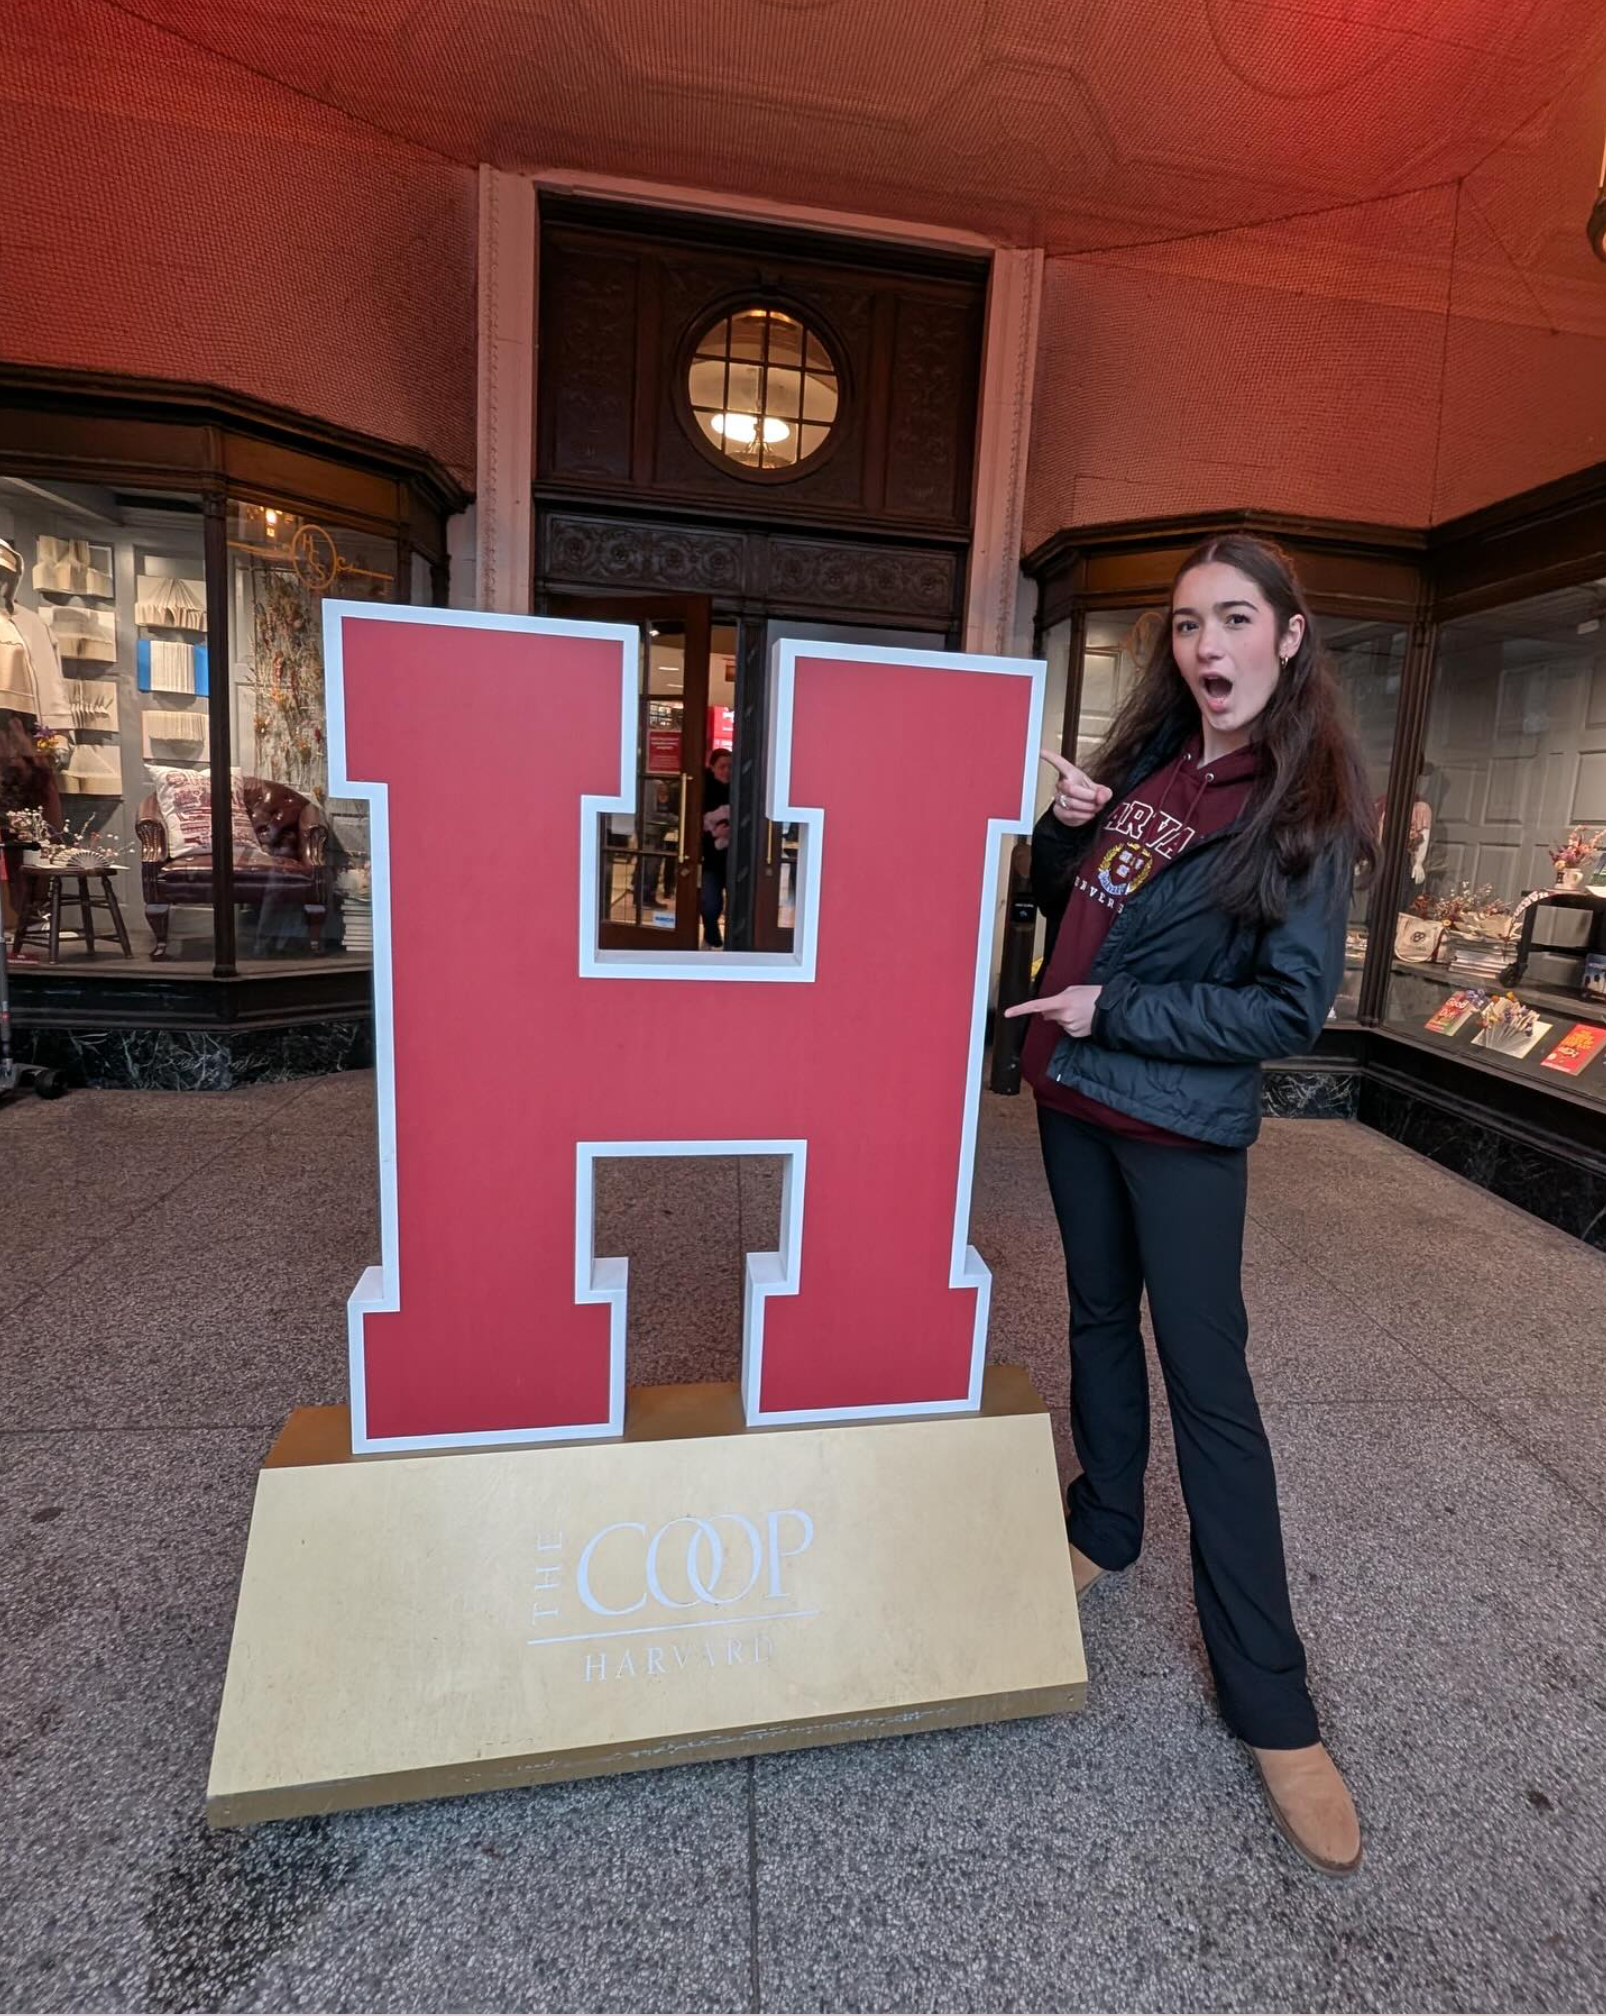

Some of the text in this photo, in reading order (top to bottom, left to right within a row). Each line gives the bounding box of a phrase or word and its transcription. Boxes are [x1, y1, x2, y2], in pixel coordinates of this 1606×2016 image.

[322, 598, 1047, 1455] H
[531, 1531, 563, 1626] THE
[576, 1507, 815, 1617] COOP
[584, 1635, 775, 1684] HARVARD
